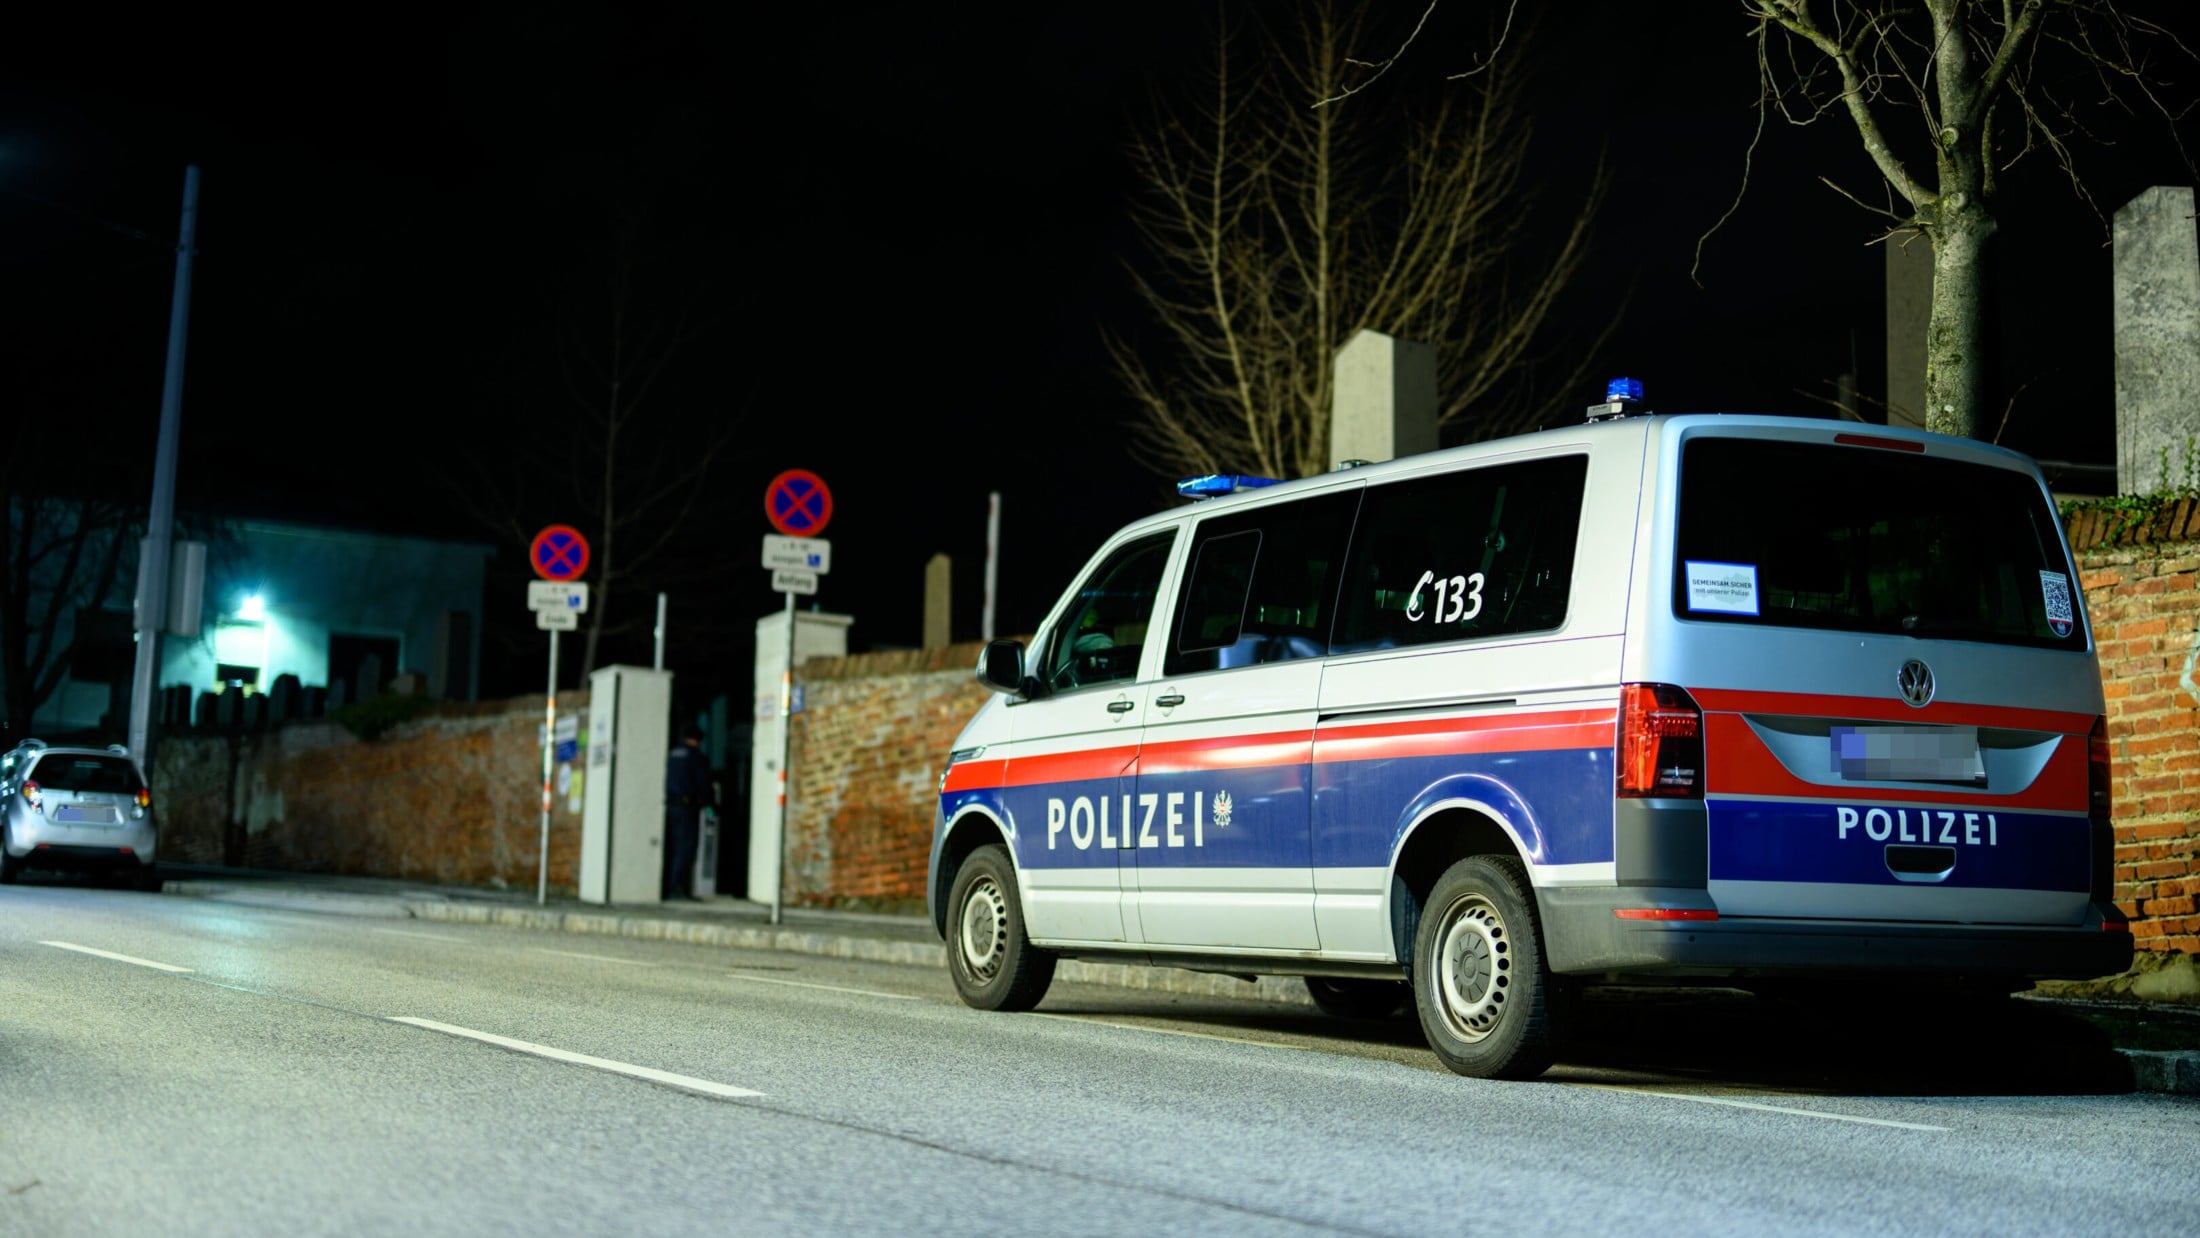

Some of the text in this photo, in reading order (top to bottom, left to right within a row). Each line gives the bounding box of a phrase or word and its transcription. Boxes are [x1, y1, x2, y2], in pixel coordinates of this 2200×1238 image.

[1434, 572, 1485, 624] 133
[1706, 588, 1730, 596] unserer
[1730, 589, 1750, 597] Polizei
[1048, 790, 1203, 850] POLIZEI
[1836, 807, 1998, 846] POLIZEI
